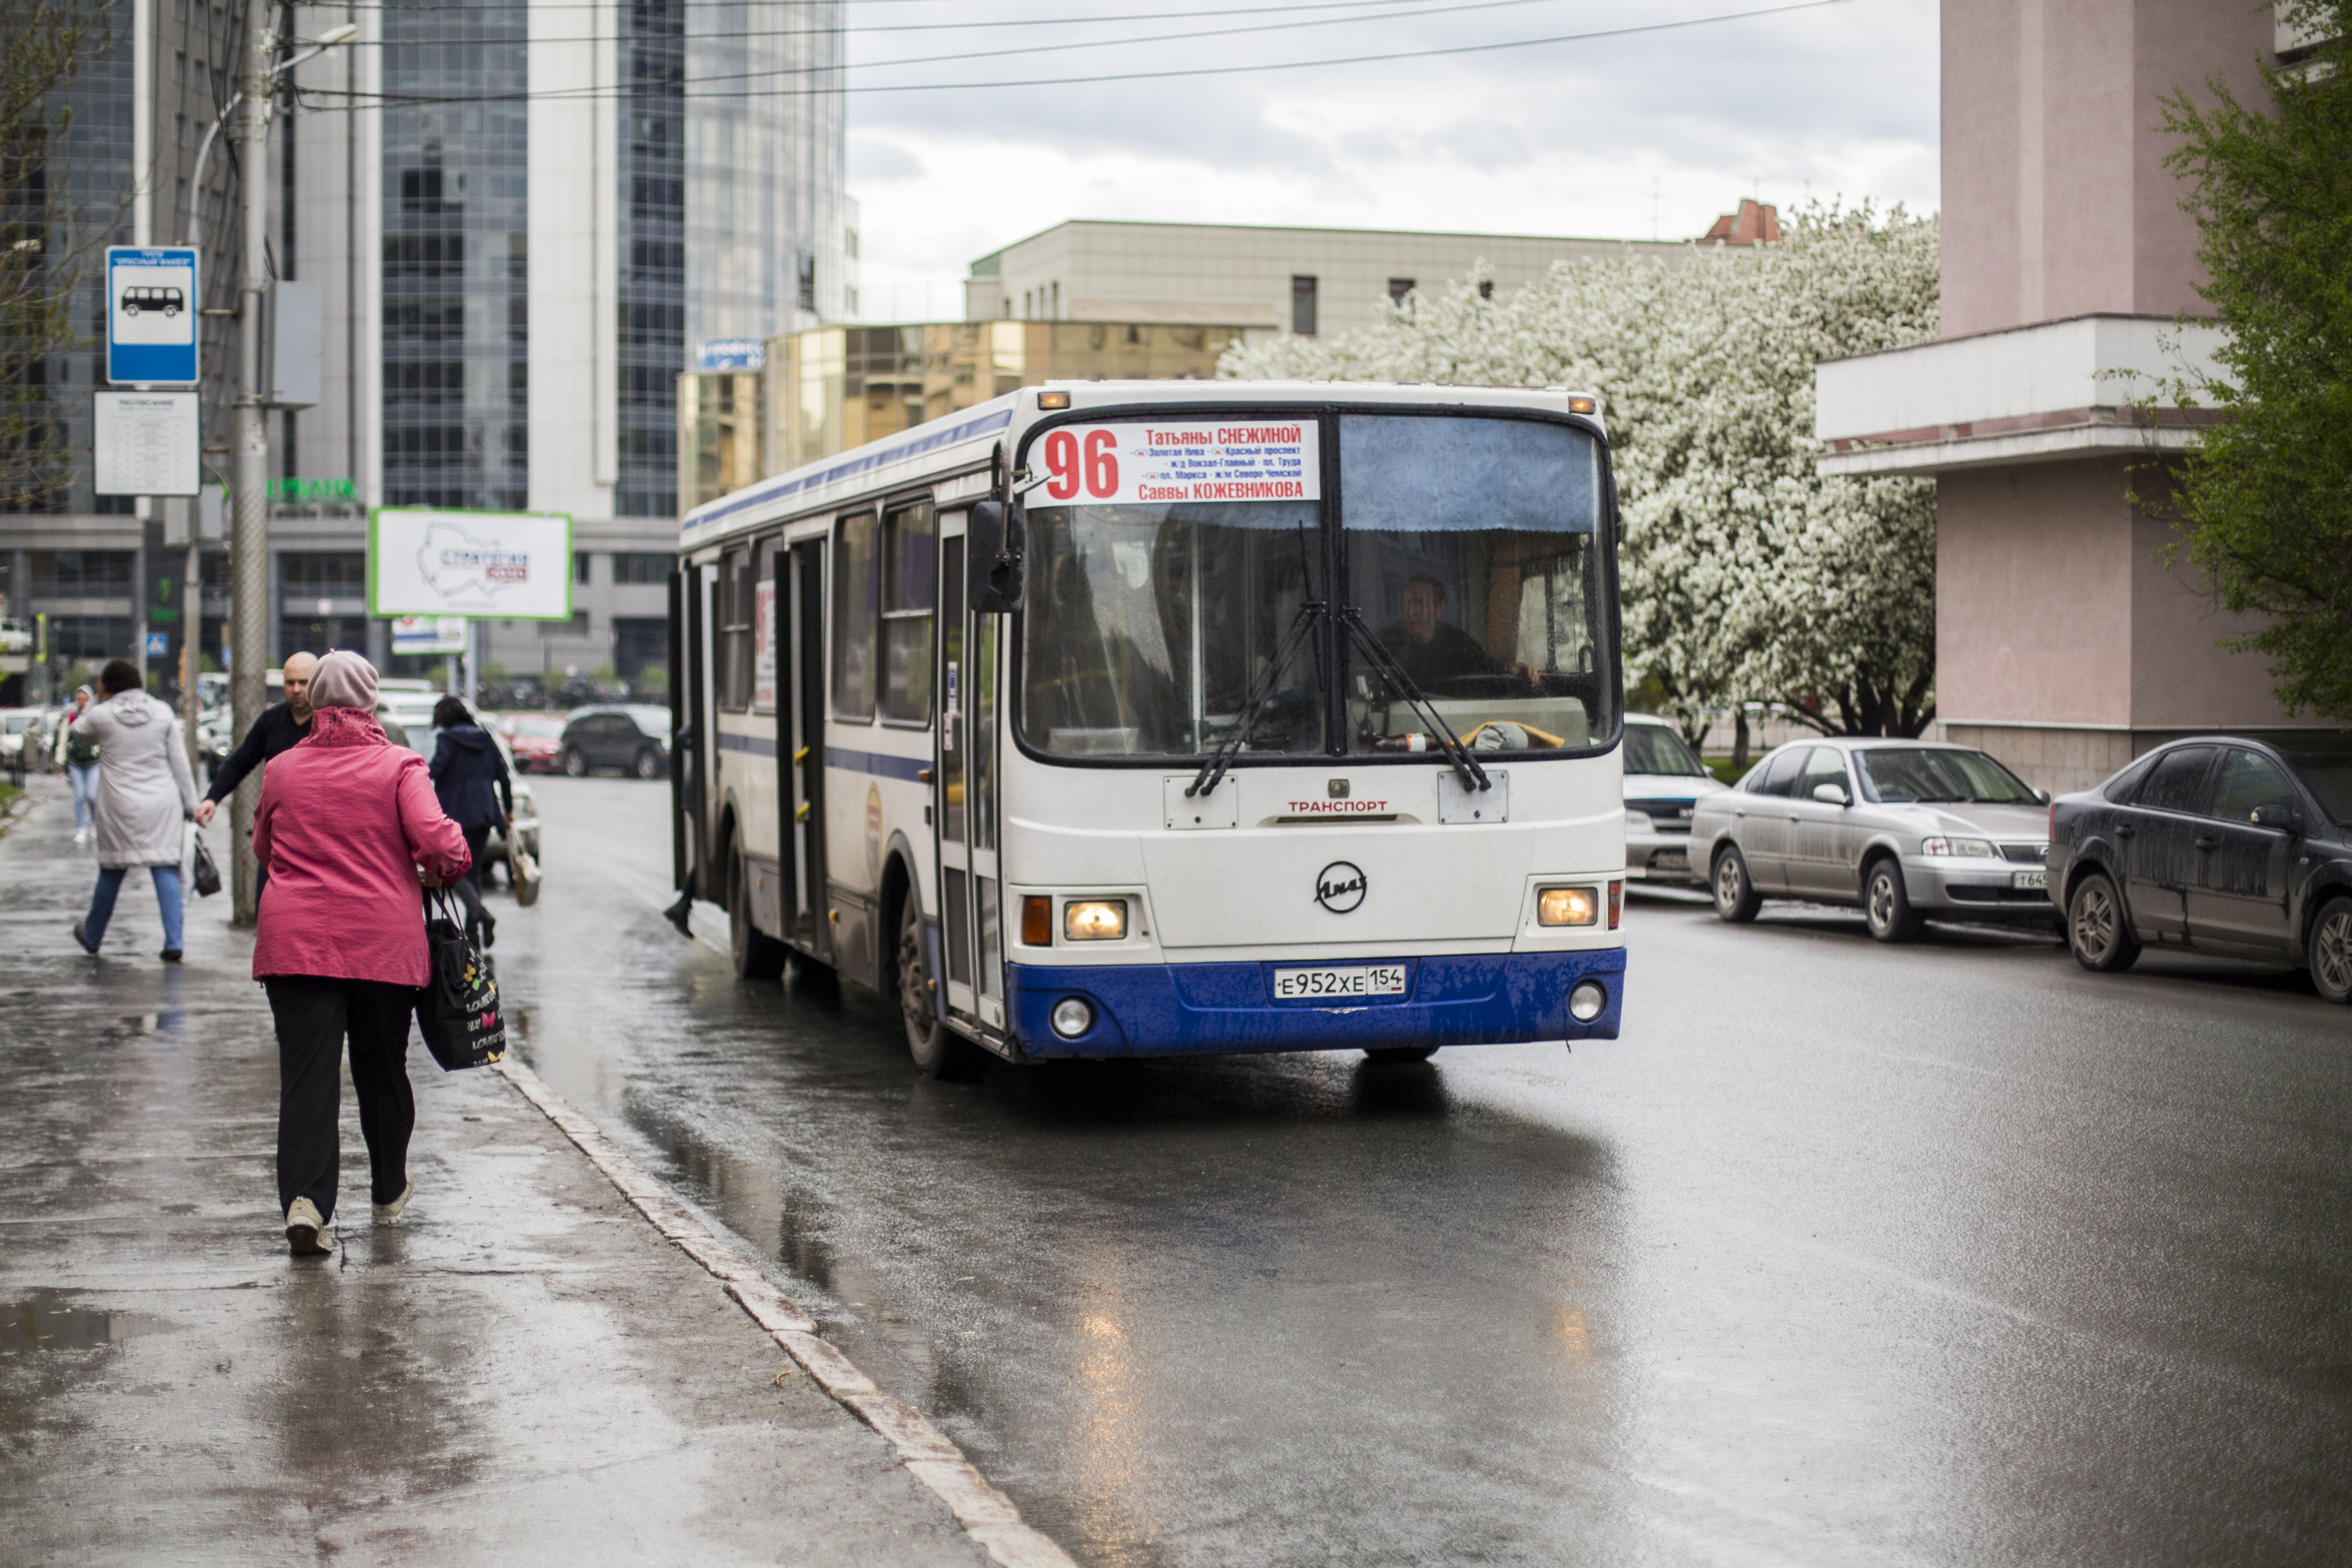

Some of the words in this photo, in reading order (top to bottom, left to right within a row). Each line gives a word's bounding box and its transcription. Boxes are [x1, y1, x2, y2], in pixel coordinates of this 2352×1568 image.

[1145, 429, 1212, 445] Татьяны
[1218, 423, 1301, 445] СНЕЖИНОЙ
[1149, 448, 1182, 457] Золотая
[1185, 447, 1204, 456] Нива
[1225, 445, 1261, 456] Красный
[1264, 447, 1301, 456] проспект
[1045, 429, 1119, 500] 96
[1171, 459, 1185, 469] ж/д
[1188, 457, 1255, 468] Вокзал-Главный
[1278, 457, 1301, 467] Труда
[1175, 470, 1207, 481] Маркса
[1234, 468, 1301, 479] Северо-Чемской
[1138, 484, 1189, 500] Саввы
[1193, 481, 1304, 499] КОЖЕВНИКОВА
[1288, 800, 1388, 812] ТРАНСПОРТ
[1282, 972, 1364, 995] Е952ХЕ
[1369, 969, 1403, 985] 154
